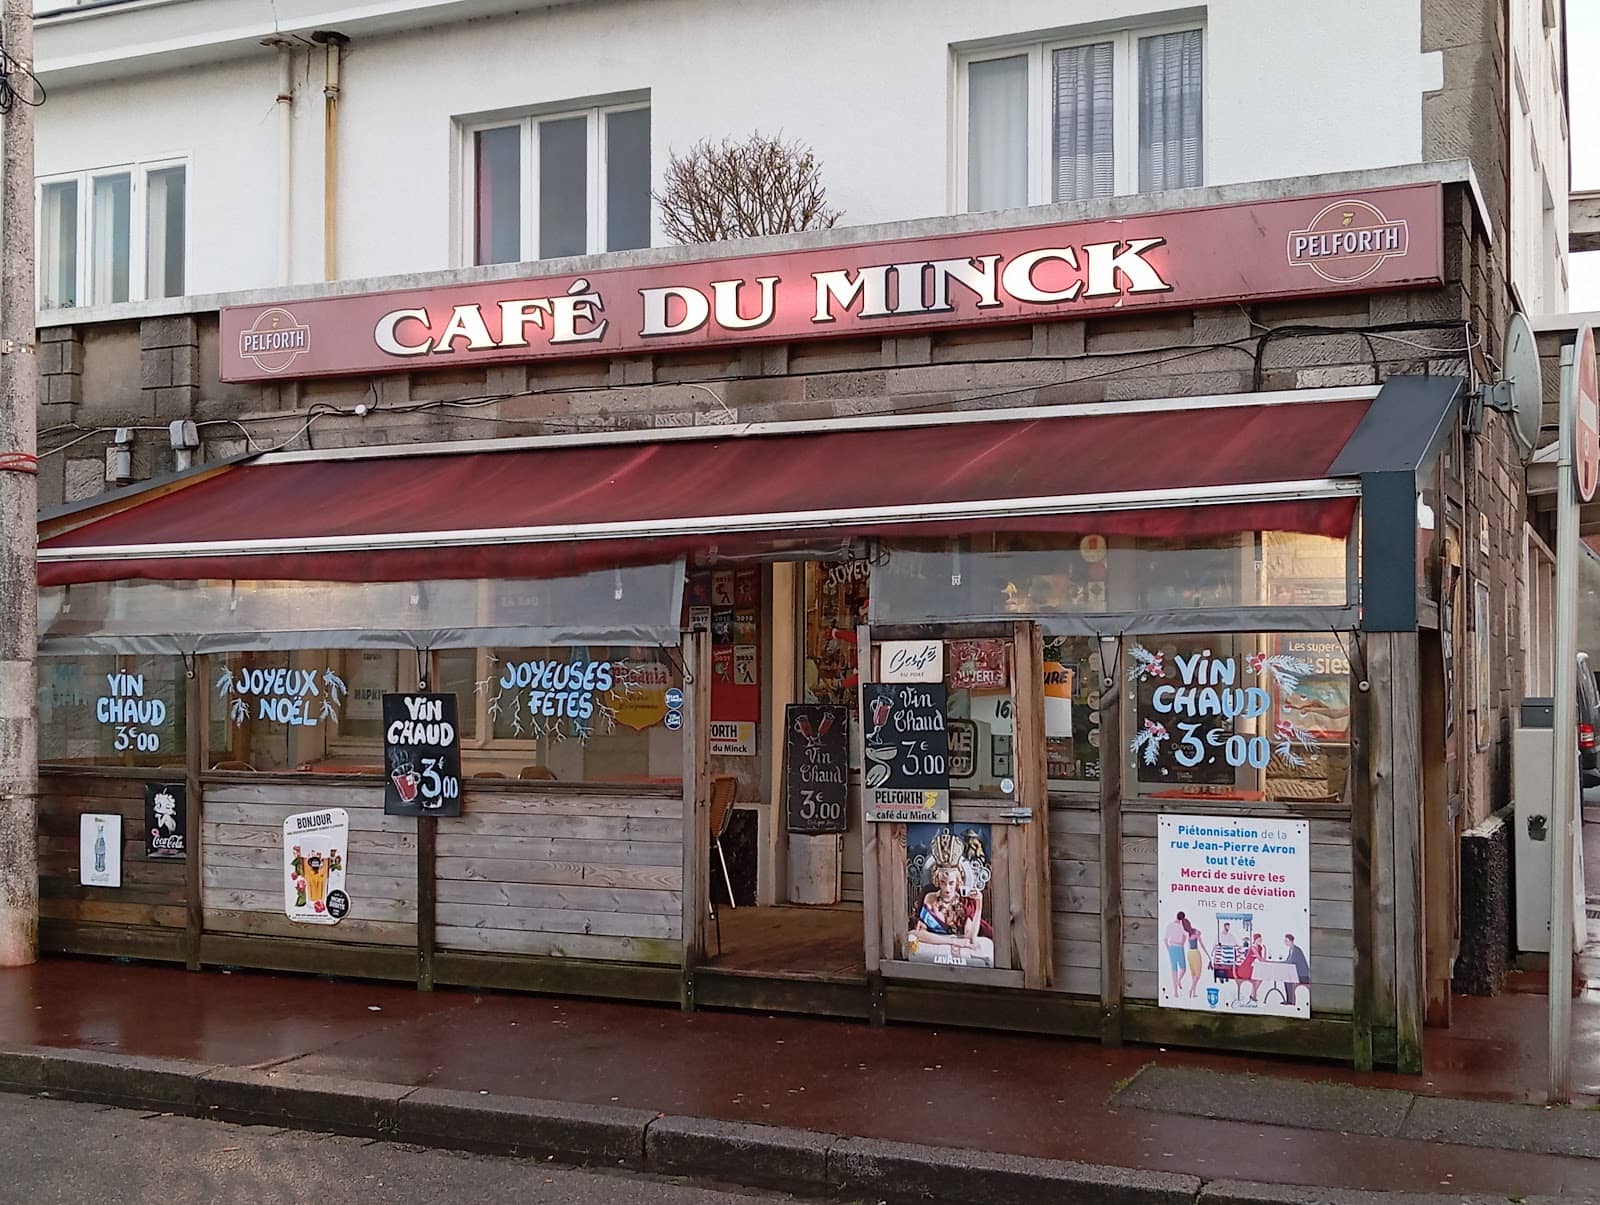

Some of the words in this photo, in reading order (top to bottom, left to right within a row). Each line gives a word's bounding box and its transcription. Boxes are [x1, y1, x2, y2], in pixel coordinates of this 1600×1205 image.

[1295, 227, 1400, 257] PELFORTH
[374, 278, 609, 357] CAFÉ
[639, 276, 781, 337] DU
[811, 237, 1173, 323] MINCK
[244, 329, 305, 352] PELFORTH
[1289, 641, 1305, 652] Les
[237, 668, 321, 697] JOYEUX
[500, 661, 612, 690] JOYEUSES
[528, 689, 594, 719] FÊTES
[900, 687, 936, 707] Vin
[1153, 685, 1271, 719] CHAUD
[97, 697, 166, 726] CHAUD
[258, 696, 318, 726] NOËL
[894, 710, 945, 731] Chaud
[387, 720, 454, 747] CHAUD
[710, 724, 737, 737] ORTH
[725, 745, 747, 753] Minck
[805, 748, 831, 764] Vin
[800, 765, 843, 784] Chaud
[875, 790, 923, 804] PELFORTH
[297, 813, 333, 830] BONJOUR
[876, 810, 894, 820] café
[897, 811, 907, 820] du
[910, 811, 937, 821] Minck
[1178, 825, 1258, 838] Piétonnisation
[1261, 829, 1274, 839] de
[1277, 830, 1287, 840] la
[1170, 841, 1189, 849] rue
[1192, 840, 1259, 853] Jean-Pierre
[1262, 844, 1296, 855] Avron
[1206, 855, 1228, 865] tout
[1231, 855, 1256, 867] l'été
[1181, 868, 1211, 879] Merci
[1214, 869, 1227, 880] de
[1230, 870, 1265, 882] suivre
[1268, 872, 1285, 883] les
[1171, 884, 1224, 895] panneaux
[1227, 884, 1241, 895] de
[1243, 885, 1296, 898] déviation
[1198, 899, 1216, 908] mis
[1220, 901, 1233, 909] en
[1236, 900, 1264, 911] place
